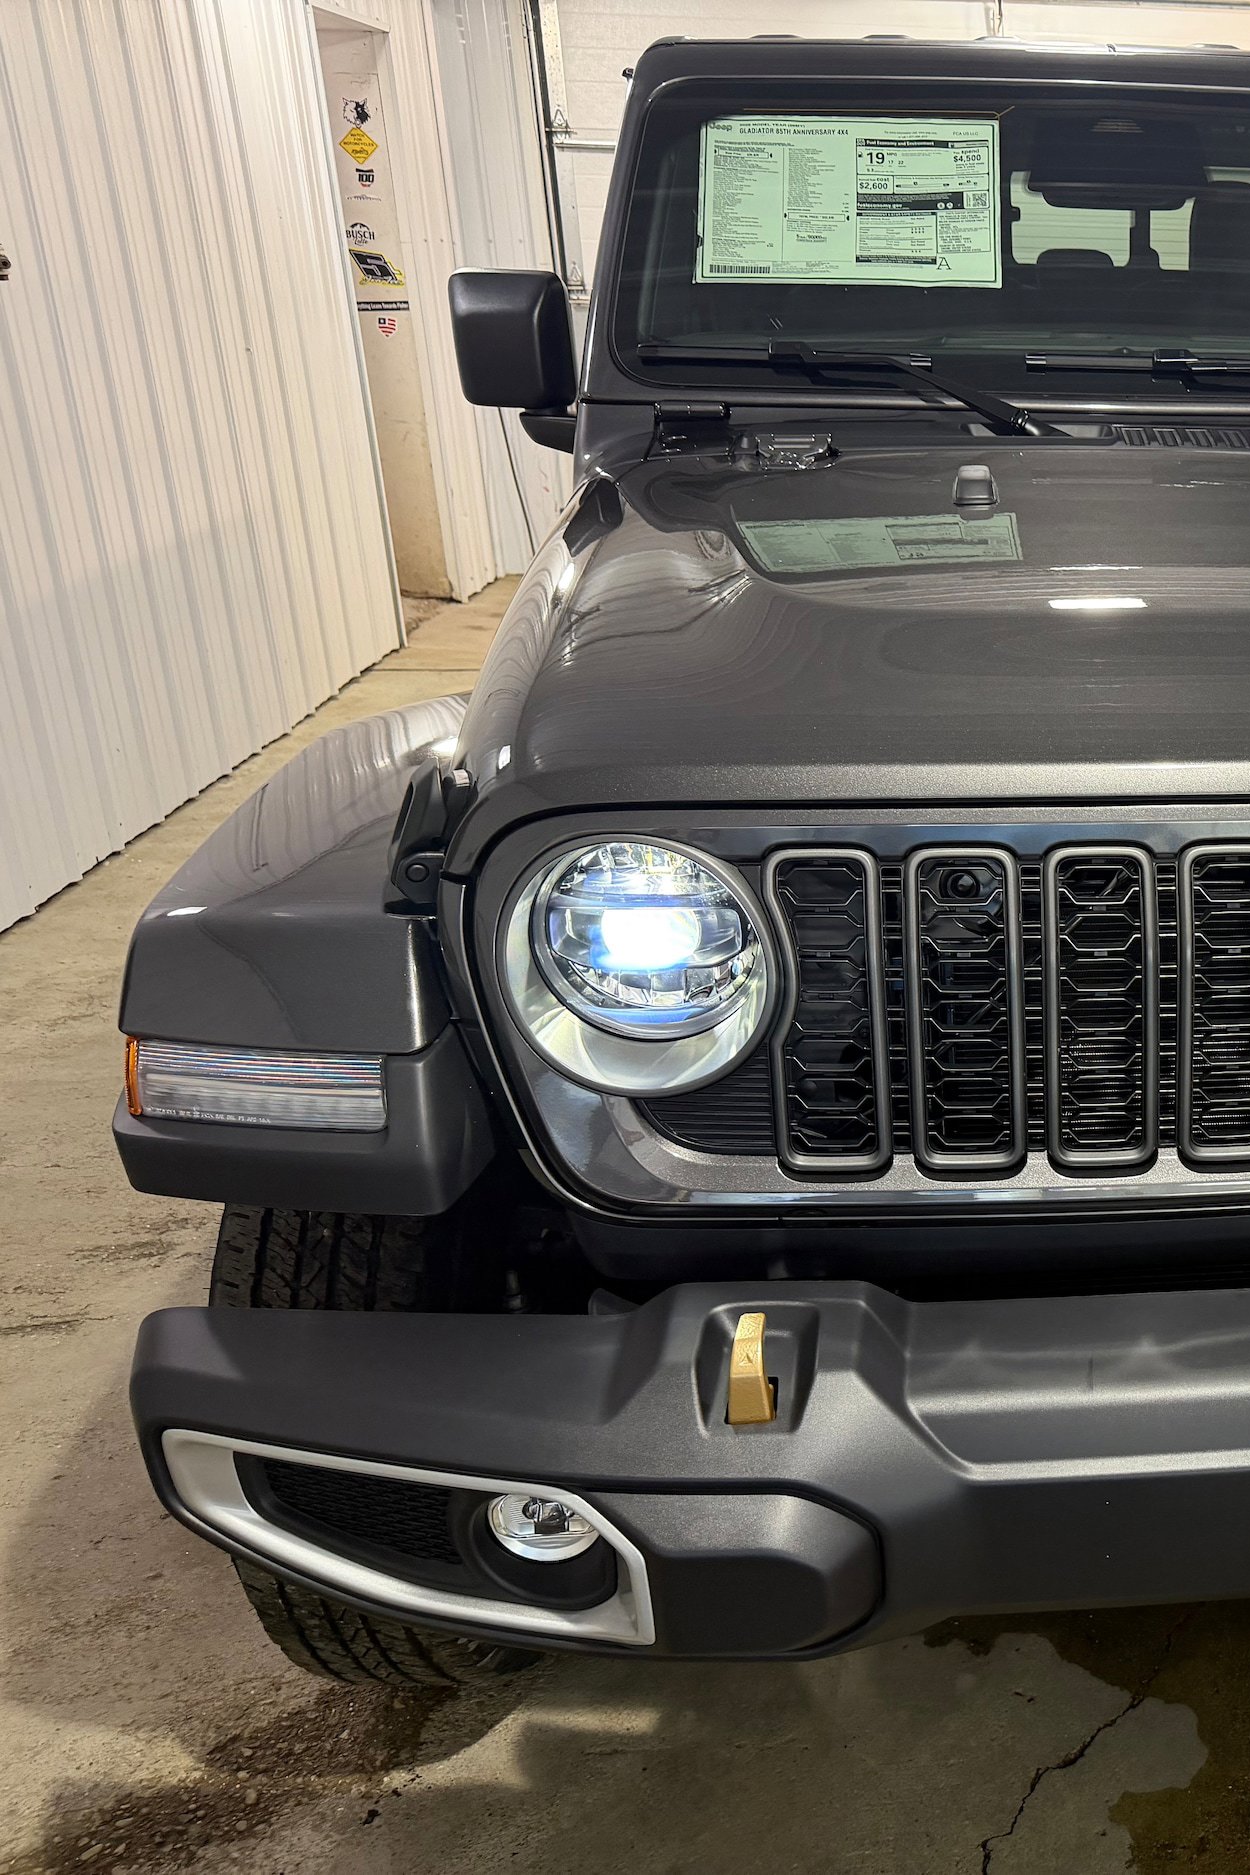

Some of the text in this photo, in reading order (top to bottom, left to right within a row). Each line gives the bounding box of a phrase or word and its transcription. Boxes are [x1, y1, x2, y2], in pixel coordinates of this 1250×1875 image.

[709, 122, 733, 132] Jeep
[792, 128, 836, 136] ANNIVERSARY
[866, 152, 885, 165] 19
[953, 154, 981, 163] $4,500
[859, 182, 888, 191] $2,600
[346, 229, 375, 240] BUSCH
[936, 257, 952, 270] A
